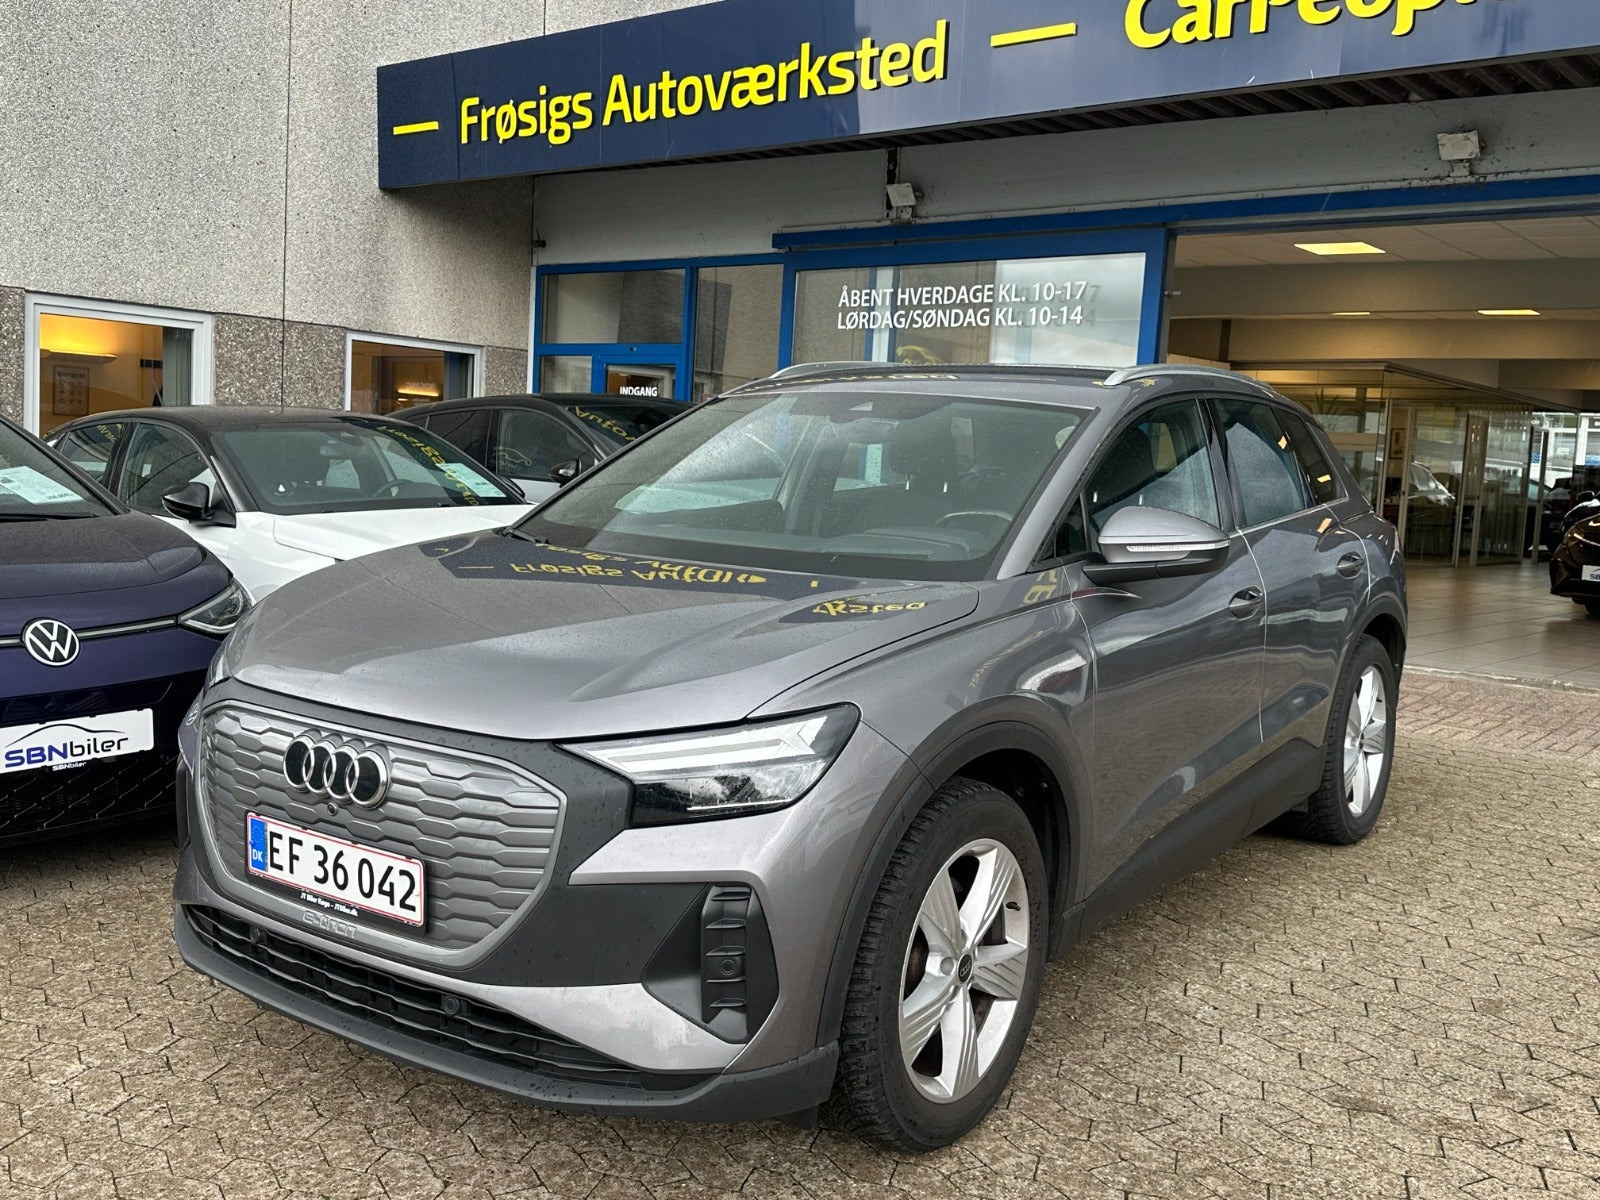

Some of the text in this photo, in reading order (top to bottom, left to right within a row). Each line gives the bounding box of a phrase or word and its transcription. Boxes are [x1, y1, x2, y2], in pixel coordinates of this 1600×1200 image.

[460, 19, 948, 144] Frøsigs Autoværksted
[839, 281, 1087, 307] ÅBENT HVERDAGE KL. 10-17
[837, 305, 1083, 330] LØRDAG/SØNDAG KL. 10-14
[619, 386, 658, 397] INDGANG
[4, 737, 129, 768] SBNbiler
[252, 848, 263, 862] DK
[269, 830, 416, 912] EF 36 042
